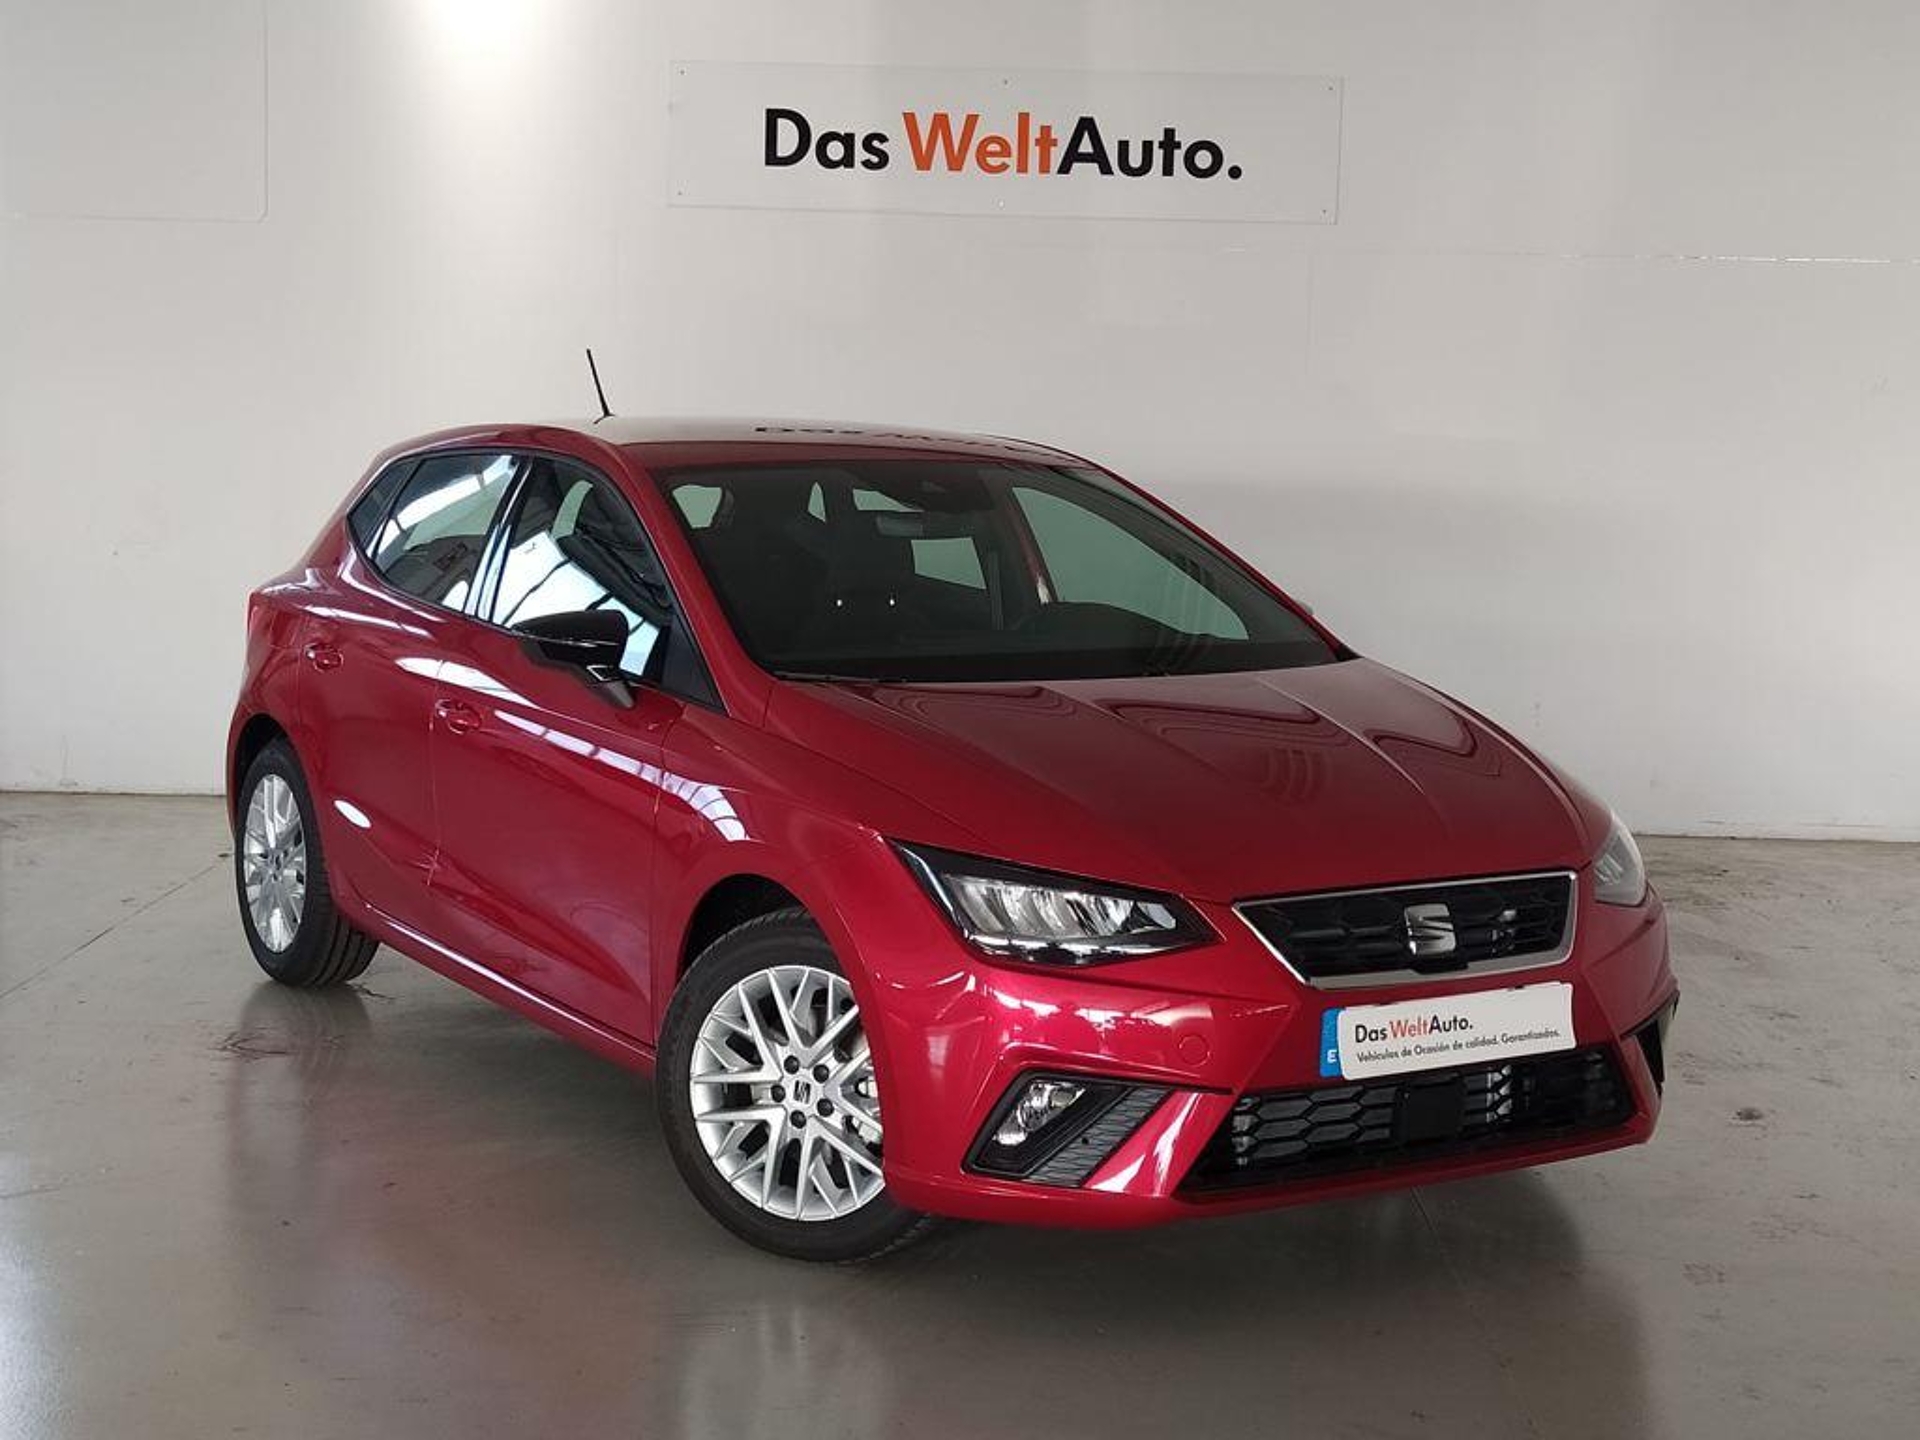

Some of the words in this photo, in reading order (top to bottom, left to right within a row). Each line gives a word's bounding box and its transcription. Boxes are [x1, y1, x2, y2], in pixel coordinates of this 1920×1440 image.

[764, 107, 889, 170] Das
[902, 111, 1243, 180] WeltAuto.
[1355, 1024, 1388, 1043] Das
[1389, 1014, 1473, 1039] WeltAuto.
[1401, 1046, 1412, 1057] de
[1452, 1039, 1463, 1051] de
